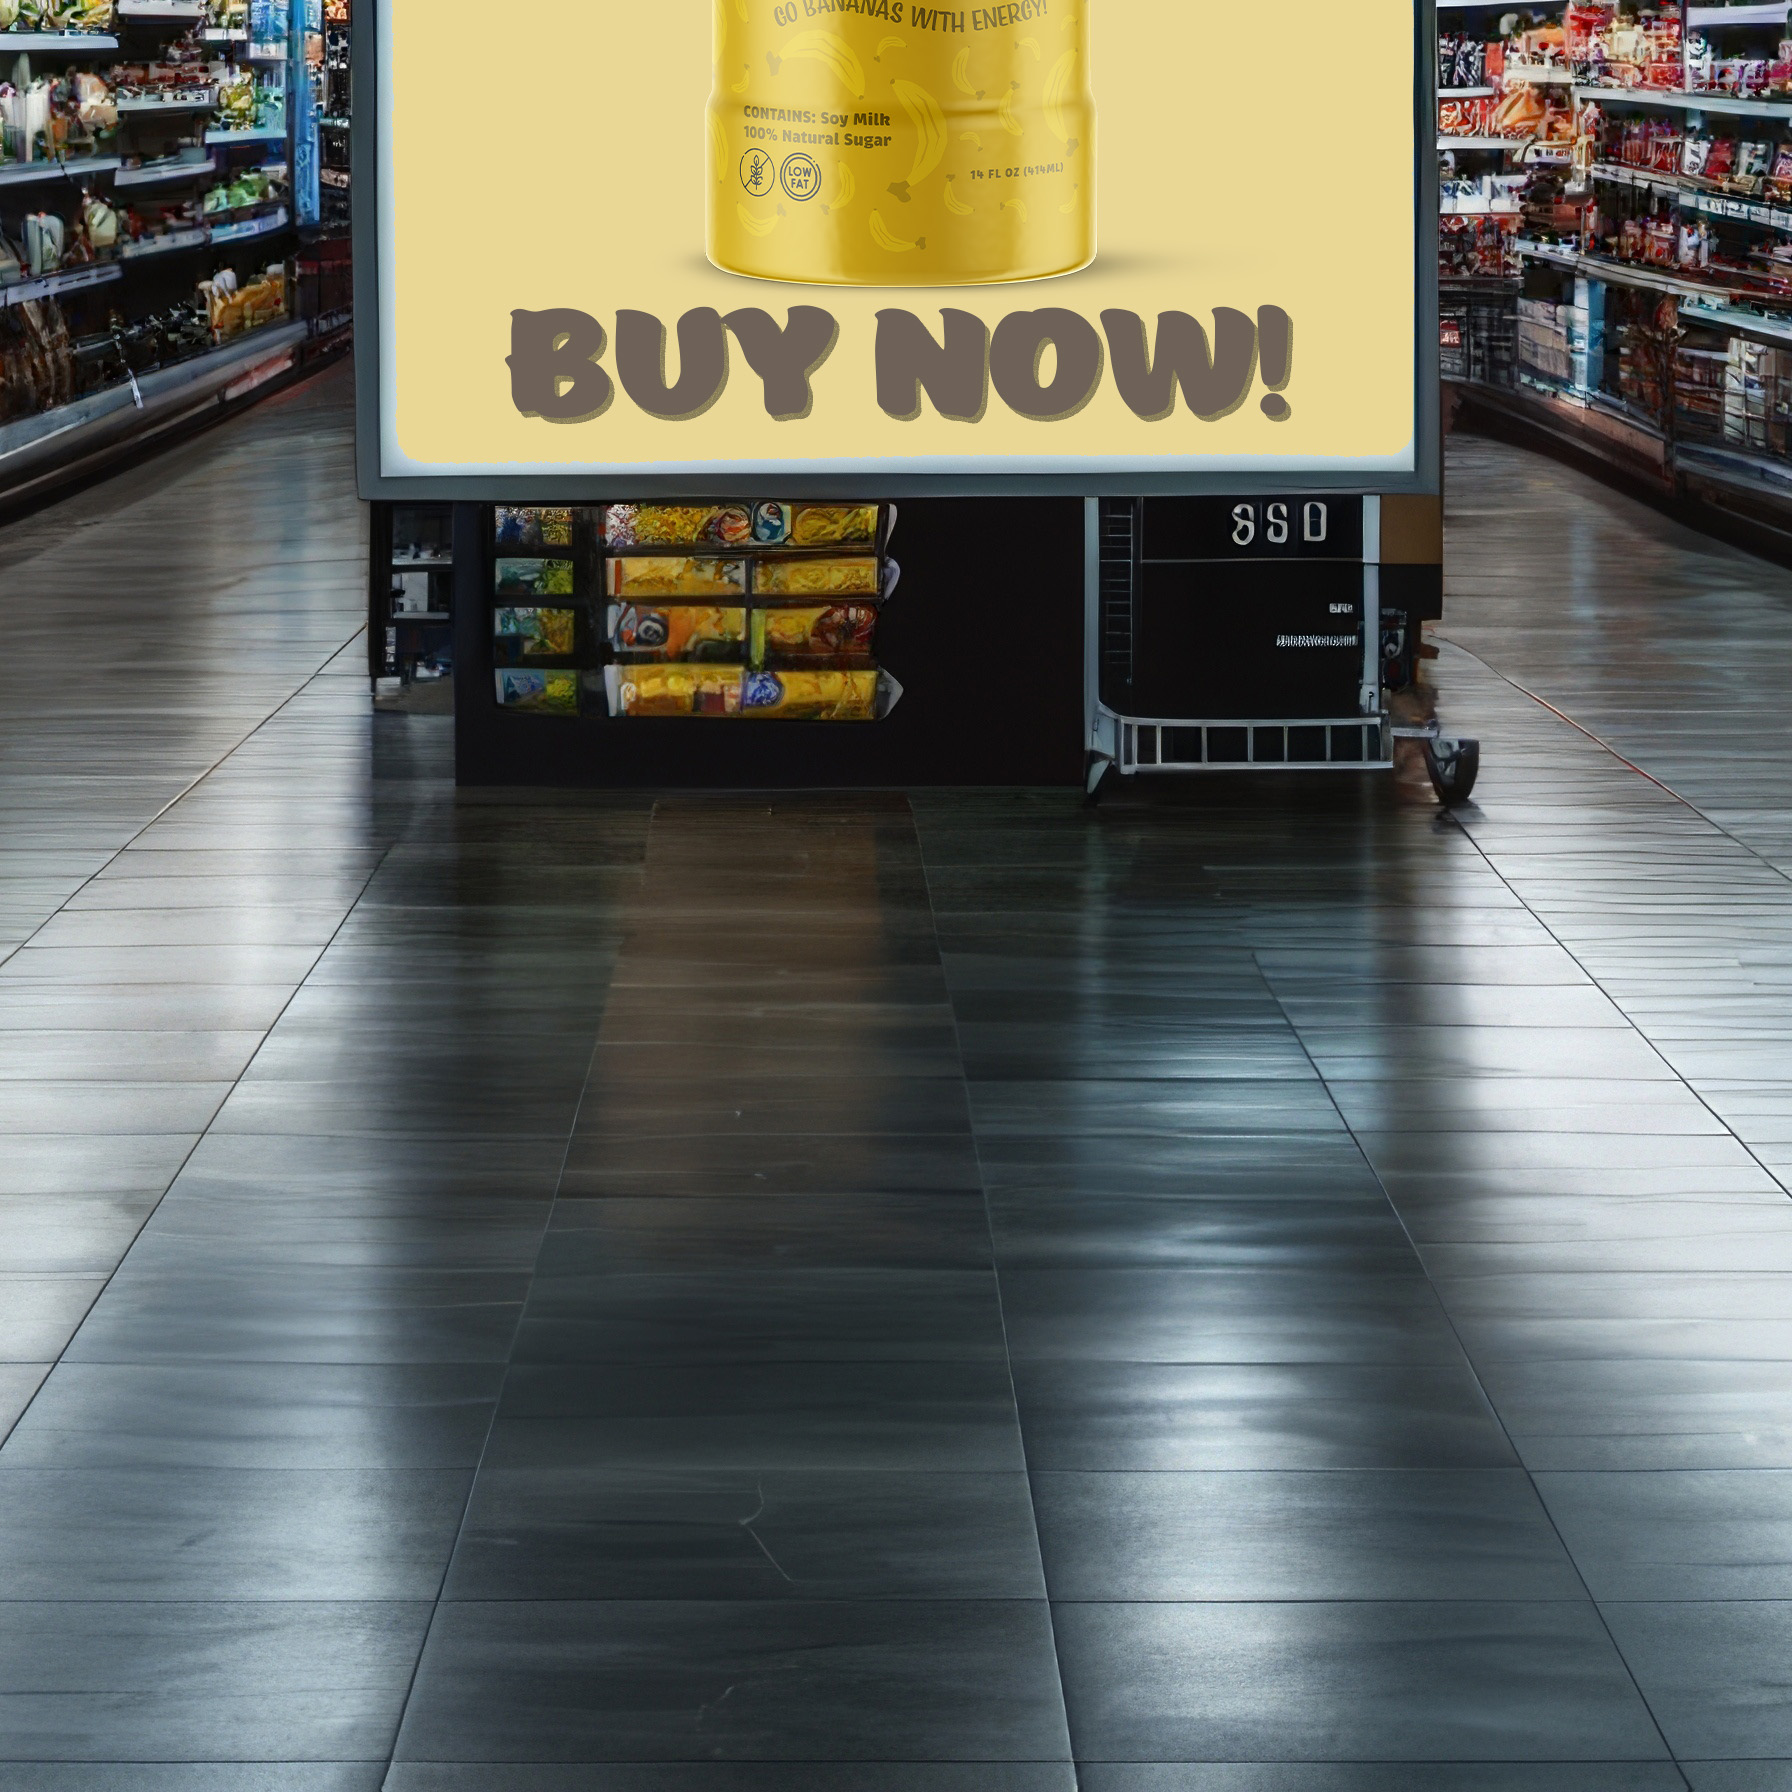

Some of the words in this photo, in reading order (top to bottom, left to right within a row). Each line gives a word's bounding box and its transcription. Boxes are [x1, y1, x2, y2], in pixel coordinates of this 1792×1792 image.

[773, 0, 799, 28] GO
[911, 4, 965, 34] WITH
[743, 104, 817, 124] CONTAINS:
[820, 111, 849, 128] Soy
[853, 111, 891, 127] Milk
[743, 125, 778, 142] 100%
[782, 129, 840, 146] Natural
[844, 133, 892, 149] Sugar
[788, 165, 812, 178] LOW
[970, 169, 985, 180] 14
[988, 168, 1002, 179] FL
[1005, 167, 1020, 178] OZ
[1023, 161, 1064, 178] (414ML)
[790, 178, 810, 190] FAT
[505, 304, 840, 424] BUY
[873, 303, 1294, 424] NOW!
